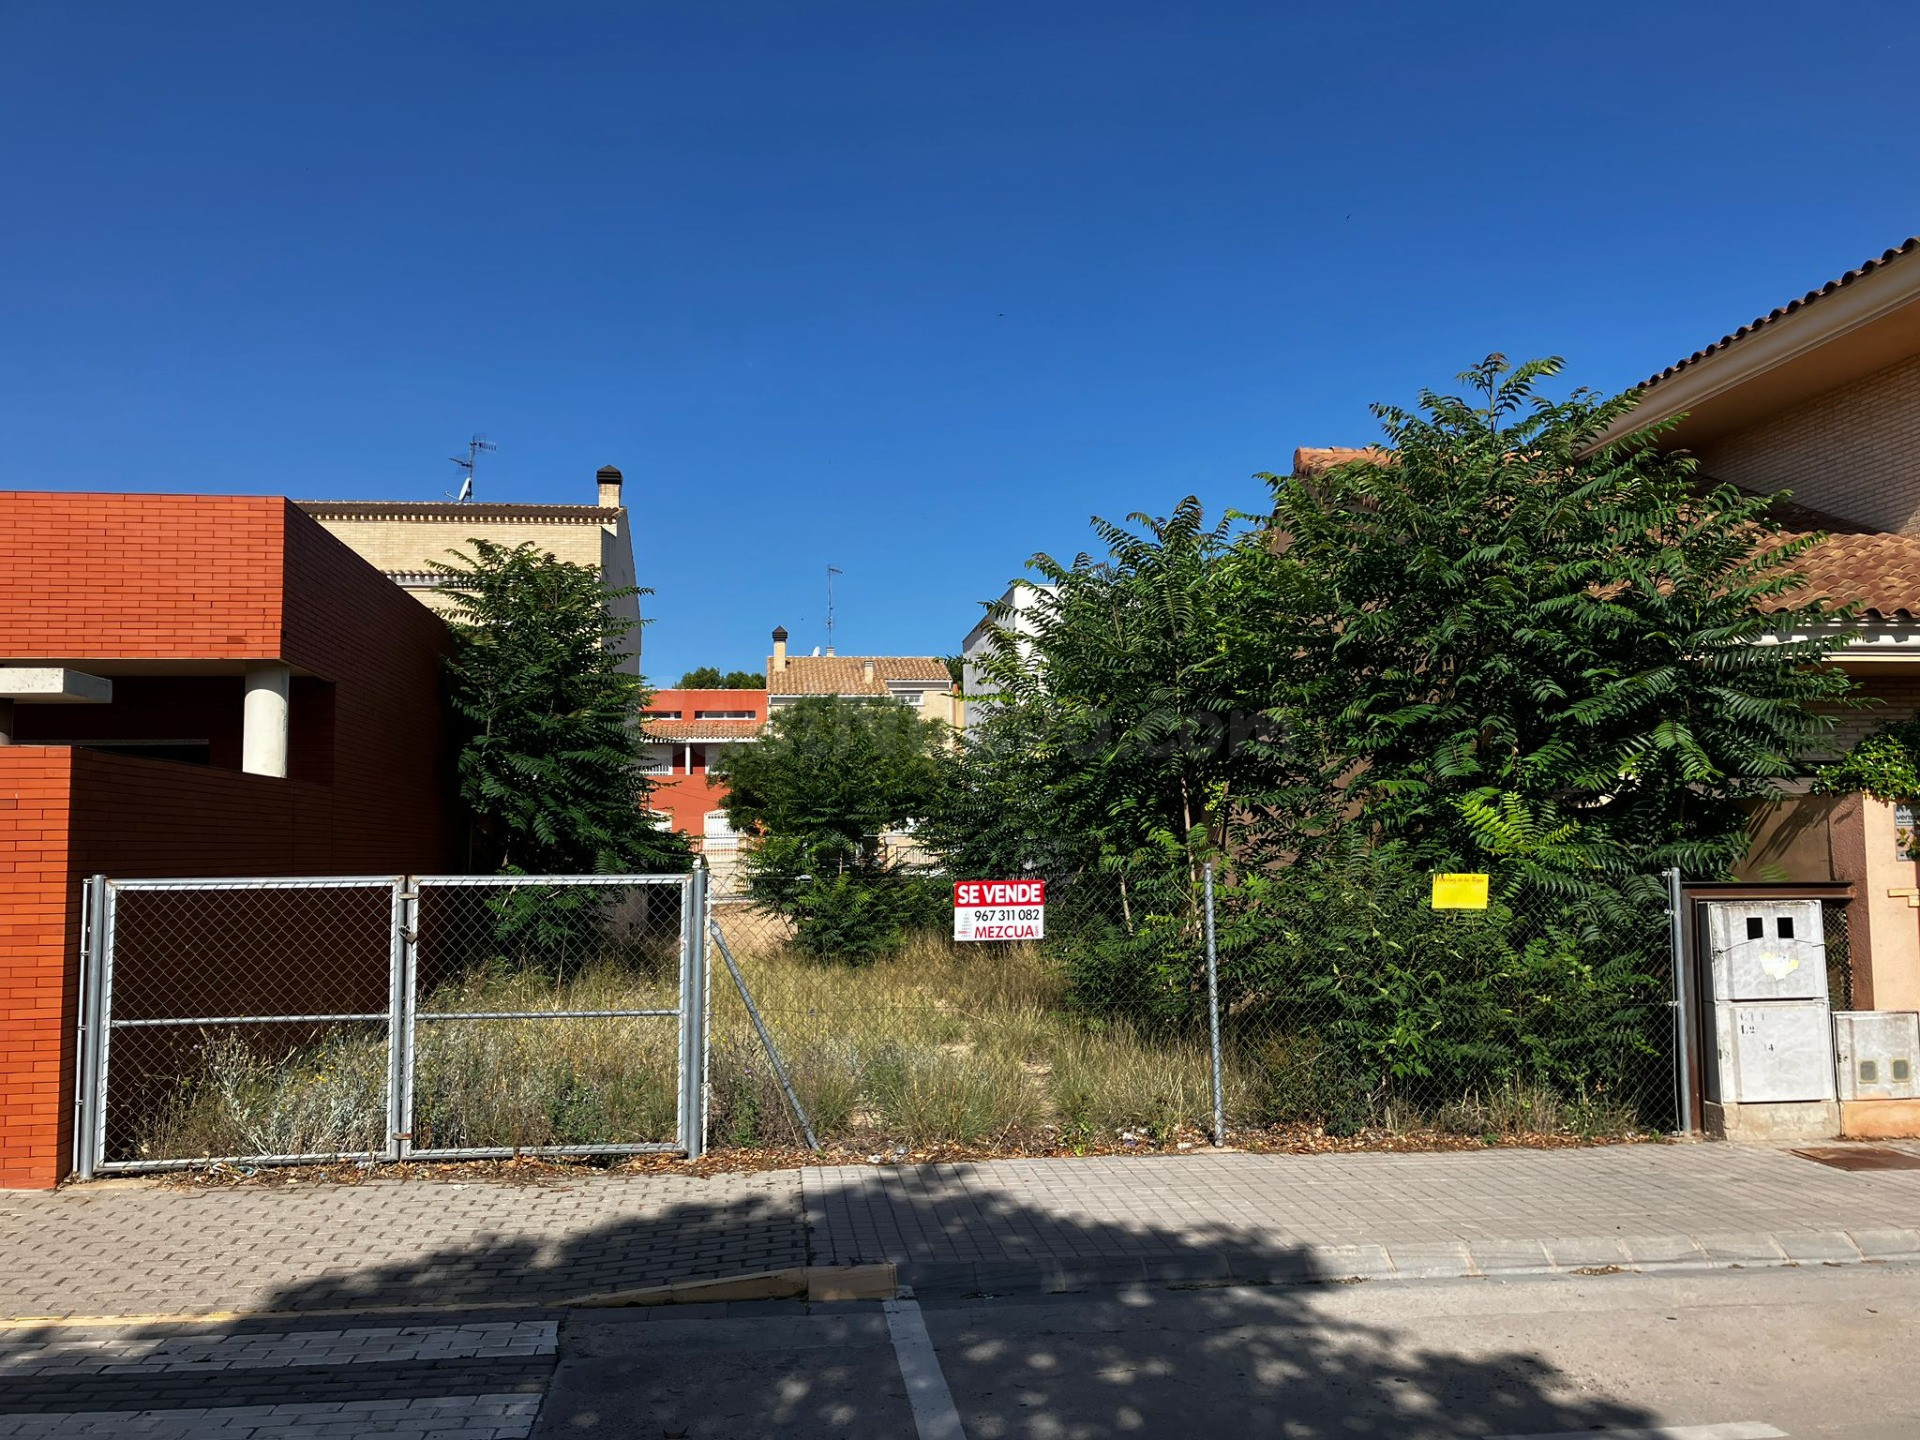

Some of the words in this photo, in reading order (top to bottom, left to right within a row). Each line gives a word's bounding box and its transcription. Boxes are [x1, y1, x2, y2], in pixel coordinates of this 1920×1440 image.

[957, 884, 980, 904] SE
[982, 883, 1041, 904] VENDE
[974, 910, 996, 921] 967
[998, 909, 1015, 921] 311
[1018, 908, 1040, 920] 082
[974, 925, 1034, 939] MEZCUA
